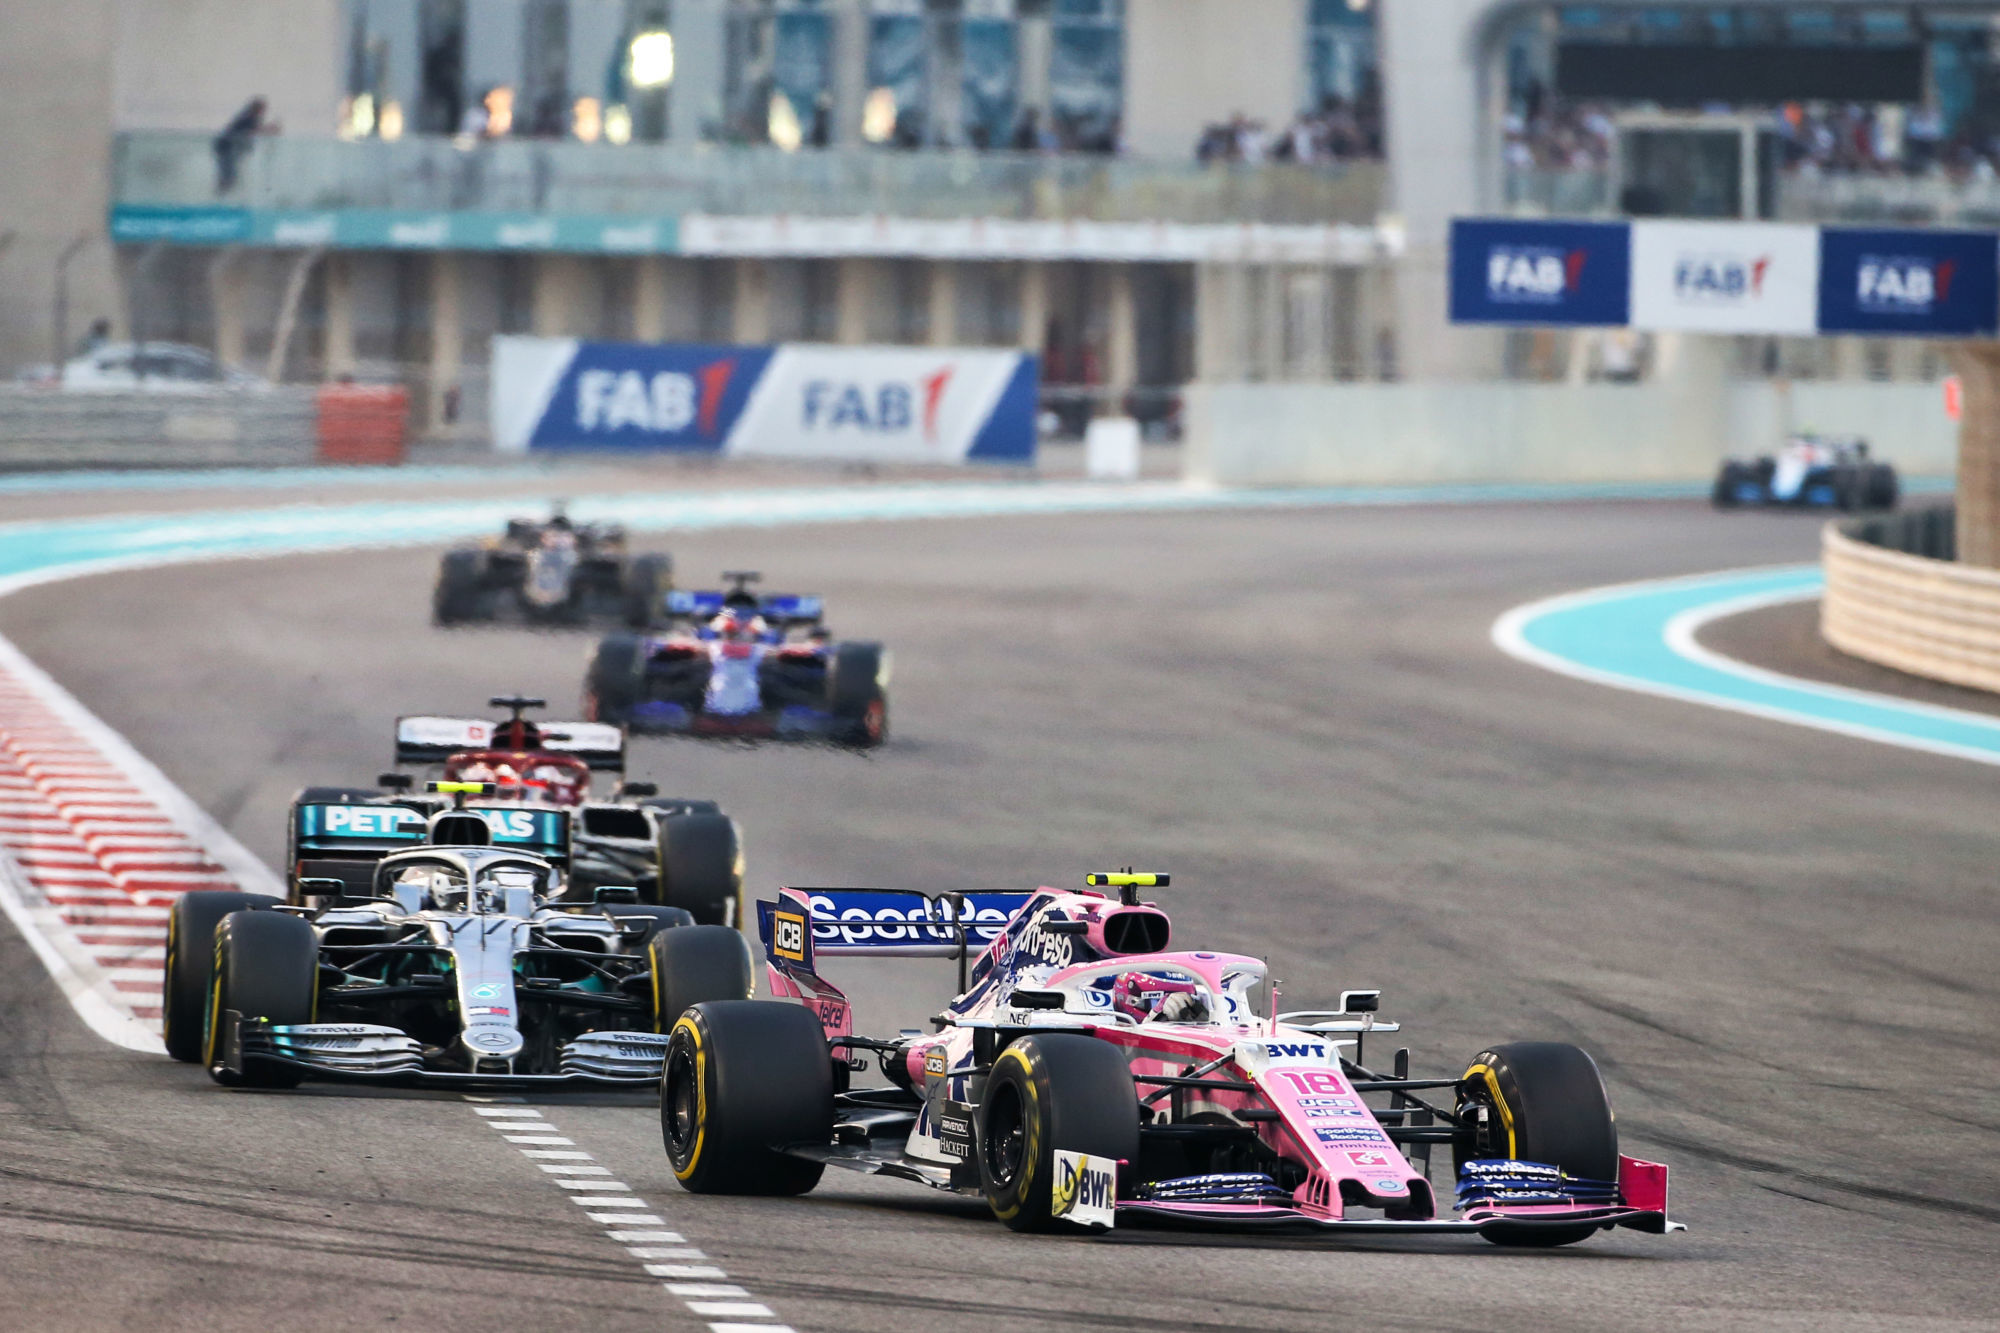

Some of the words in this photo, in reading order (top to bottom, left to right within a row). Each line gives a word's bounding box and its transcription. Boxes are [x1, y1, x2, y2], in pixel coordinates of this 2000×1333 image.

[1488, 254, 1565, 294] FAB
[1674, 260, 1746, 297] FAB
[1858, 264, 1933, 303] FAB
[576, 369, 696, 432] FAB
[802, 380, 911, 432] FAB
[776, 920, 801, 951] JCB
[305, 1026, 366, 1034] PETRONAS
[1009, 1012, 1029, 1026] NEC
[1265, 1043, 1325, 1058] BWT
[926, 1058, 944, 1073] JCB
[1281, 1071, 1347, 1096] 18
[1305, 1109, 1364, 1118] NEC
[940, 1136, 970, 1158] HACKETT
[1329, 1133, 1371, 1141] Racing
